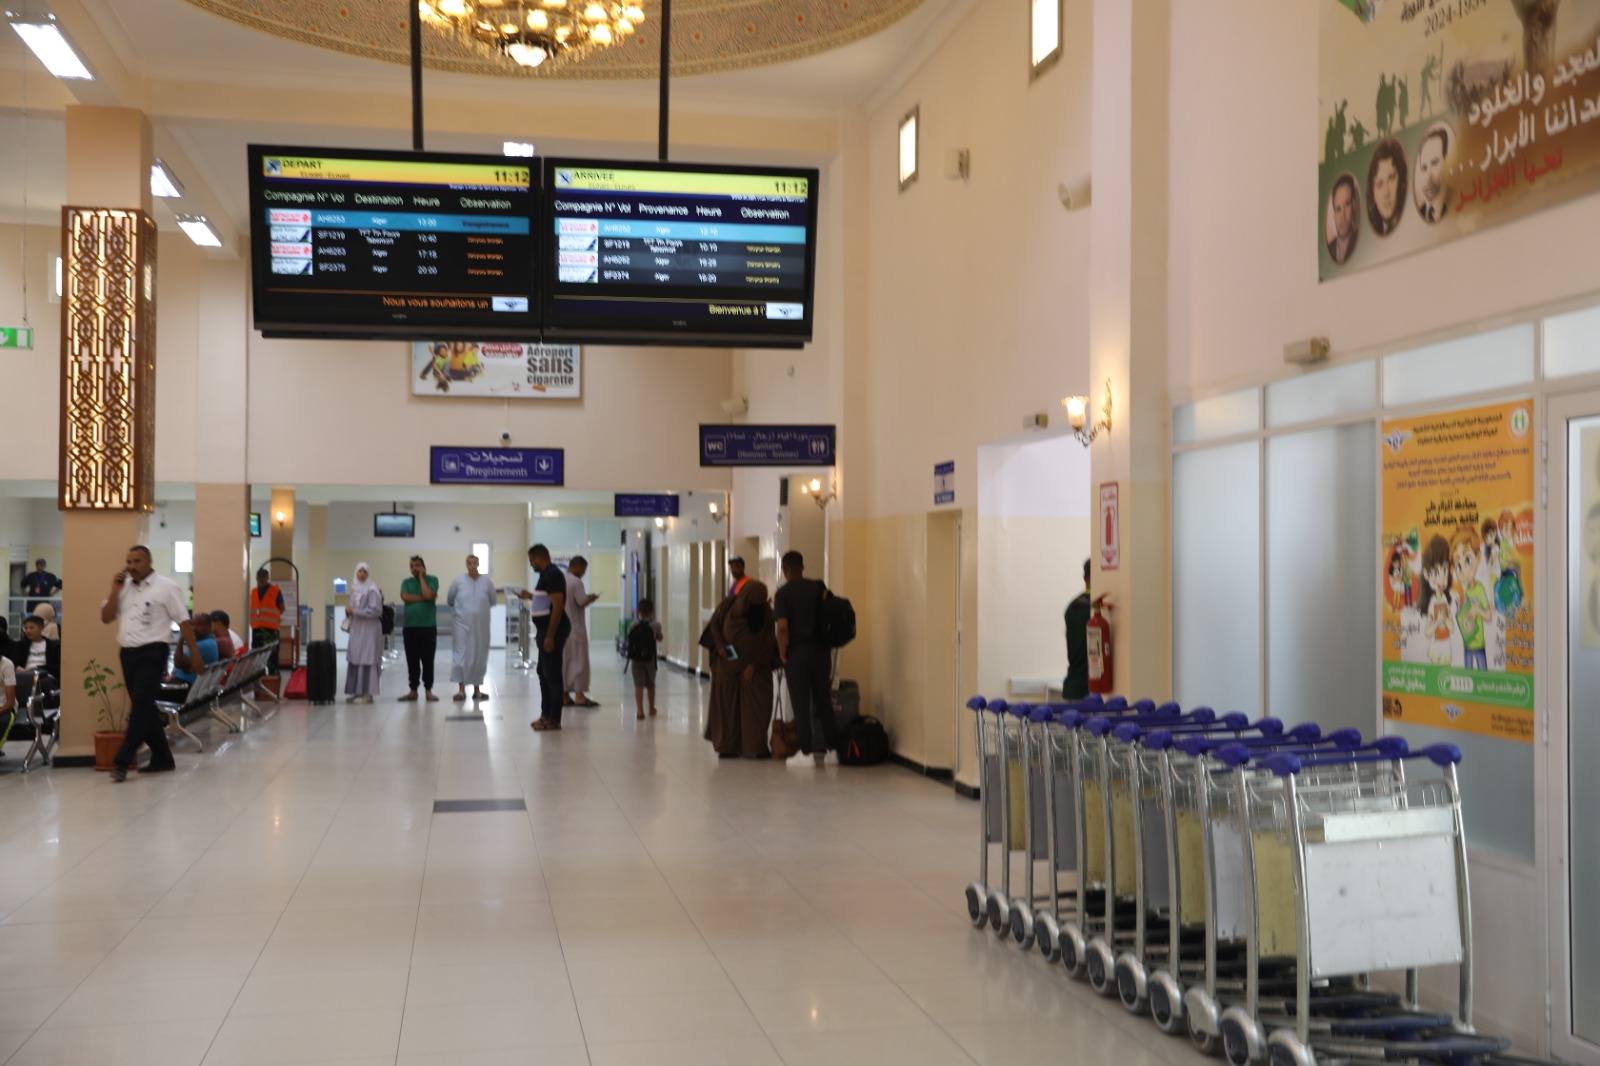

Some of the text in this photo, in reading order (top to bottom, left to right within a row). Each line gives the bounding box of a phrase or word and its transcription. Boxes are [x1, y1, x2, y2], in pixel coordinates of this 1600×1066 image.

[1468, 71, 1546, 127] والخلود
[283, 159, 323, 169] DEPART
[495, 170, 529, 183] 11:12
[775, 181, 807, 193] 11:12
[264, 189, 345, 203] Compagnie N° Vol
[354, 193, 403, 206] Destination
[413, 196, 440, 207] Heure
[460, 197, 511, 210] Observation
[554, 200, 631, 213] Compagnie N° Vol
[639, 203, 688, 215] Provenance
[696, 205, 722, 217] Heure
[740, 207, 789, 219] Observation
[383, 296, 489, 309] Nous vous souhaitons un
[708, 304, 752, 316] Bienvenue
[753, 306, 759, 316] à
[527, 358, 574, 374] sans
[527, 373, 574, 386] cigarette
[708, 441, 724, 451] WC
[465, 465, 528, 479] Enregistrements
